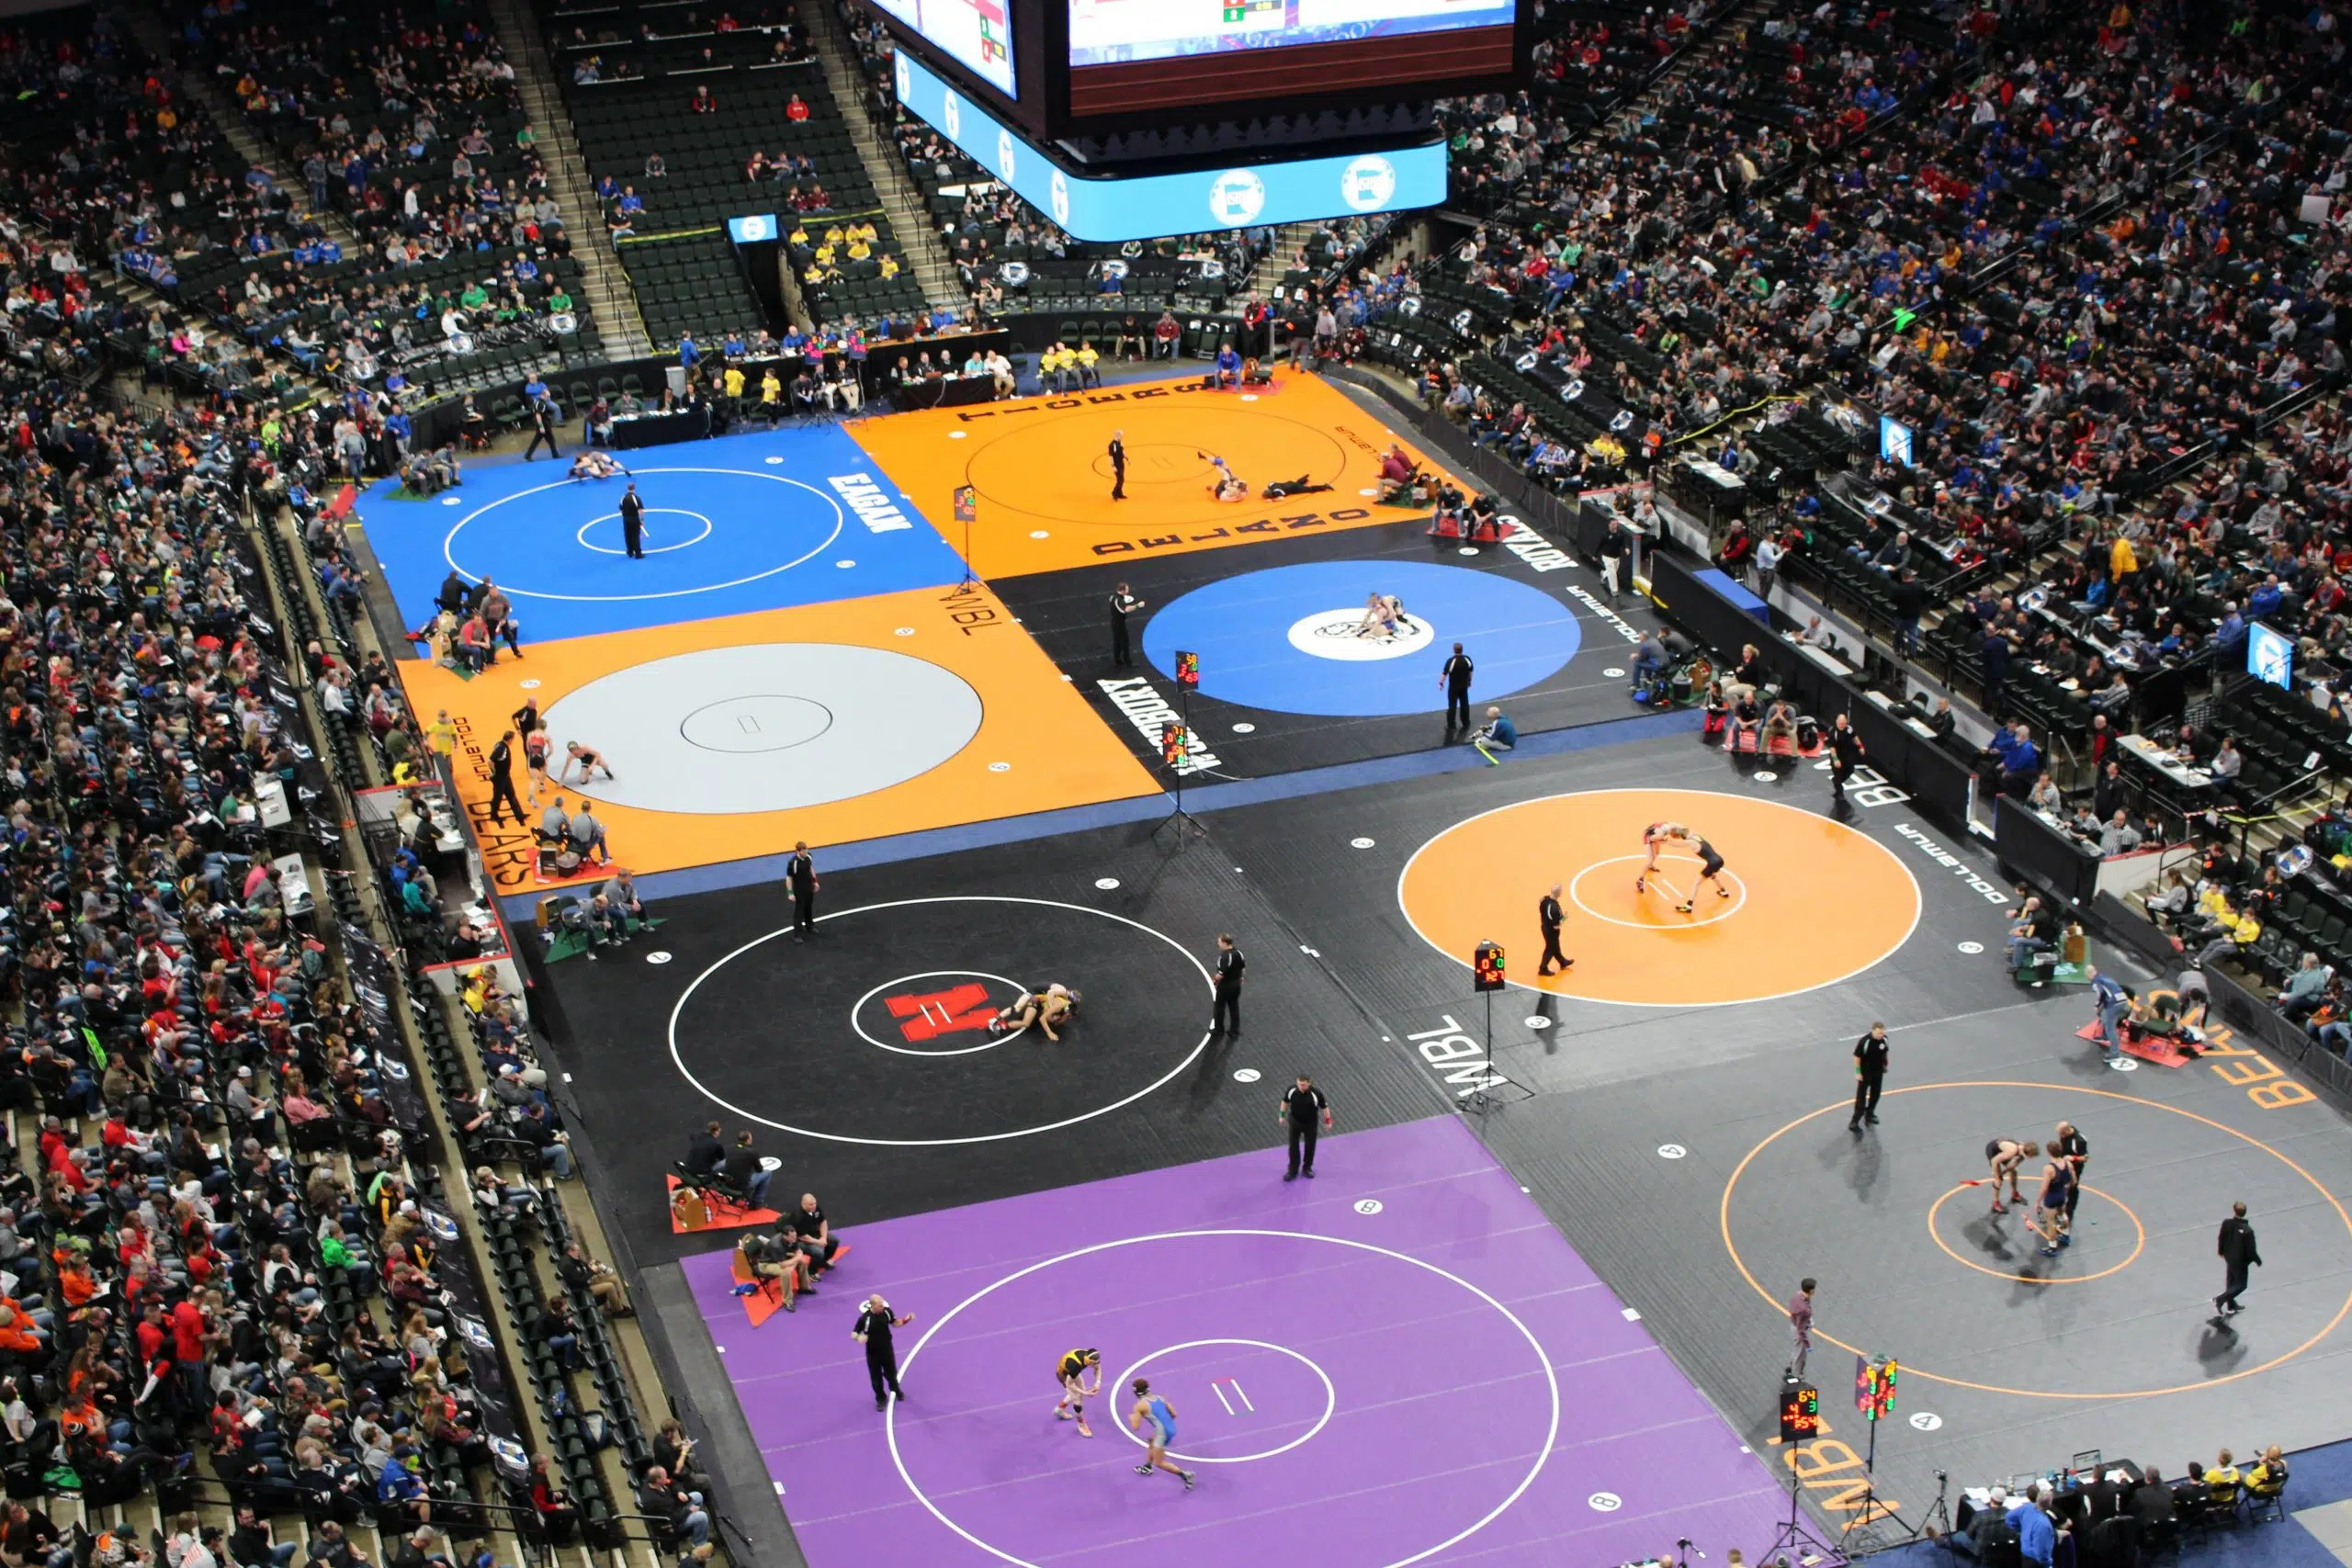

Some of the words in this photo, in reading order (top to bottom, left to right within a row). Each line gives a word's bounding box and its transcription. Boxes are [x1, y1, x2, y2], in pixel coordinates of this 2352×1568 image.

[957, 382, 1207, 422] TIGERS
[827, 472, 913, 534] EAGAN
[1091, 508, 1370, 555] DELANO
[1489, 948, 1504, 959] 67
[1481, 958, 1489, 970] 0
[1497, 957, 1504, 968] 0
[1407, 1014, 1510, 1099] WBL
[1361, 1201, 1376, 1213] 8
[1798, 1389, 1816, 1403] 64
[1789, 1404, 1799, 1415] 4
[1808, 1400, 1817, 1413] 3
[1915, 1416, 1935, 1428] 4
[1592, 1495, 1618, 1508] 8
